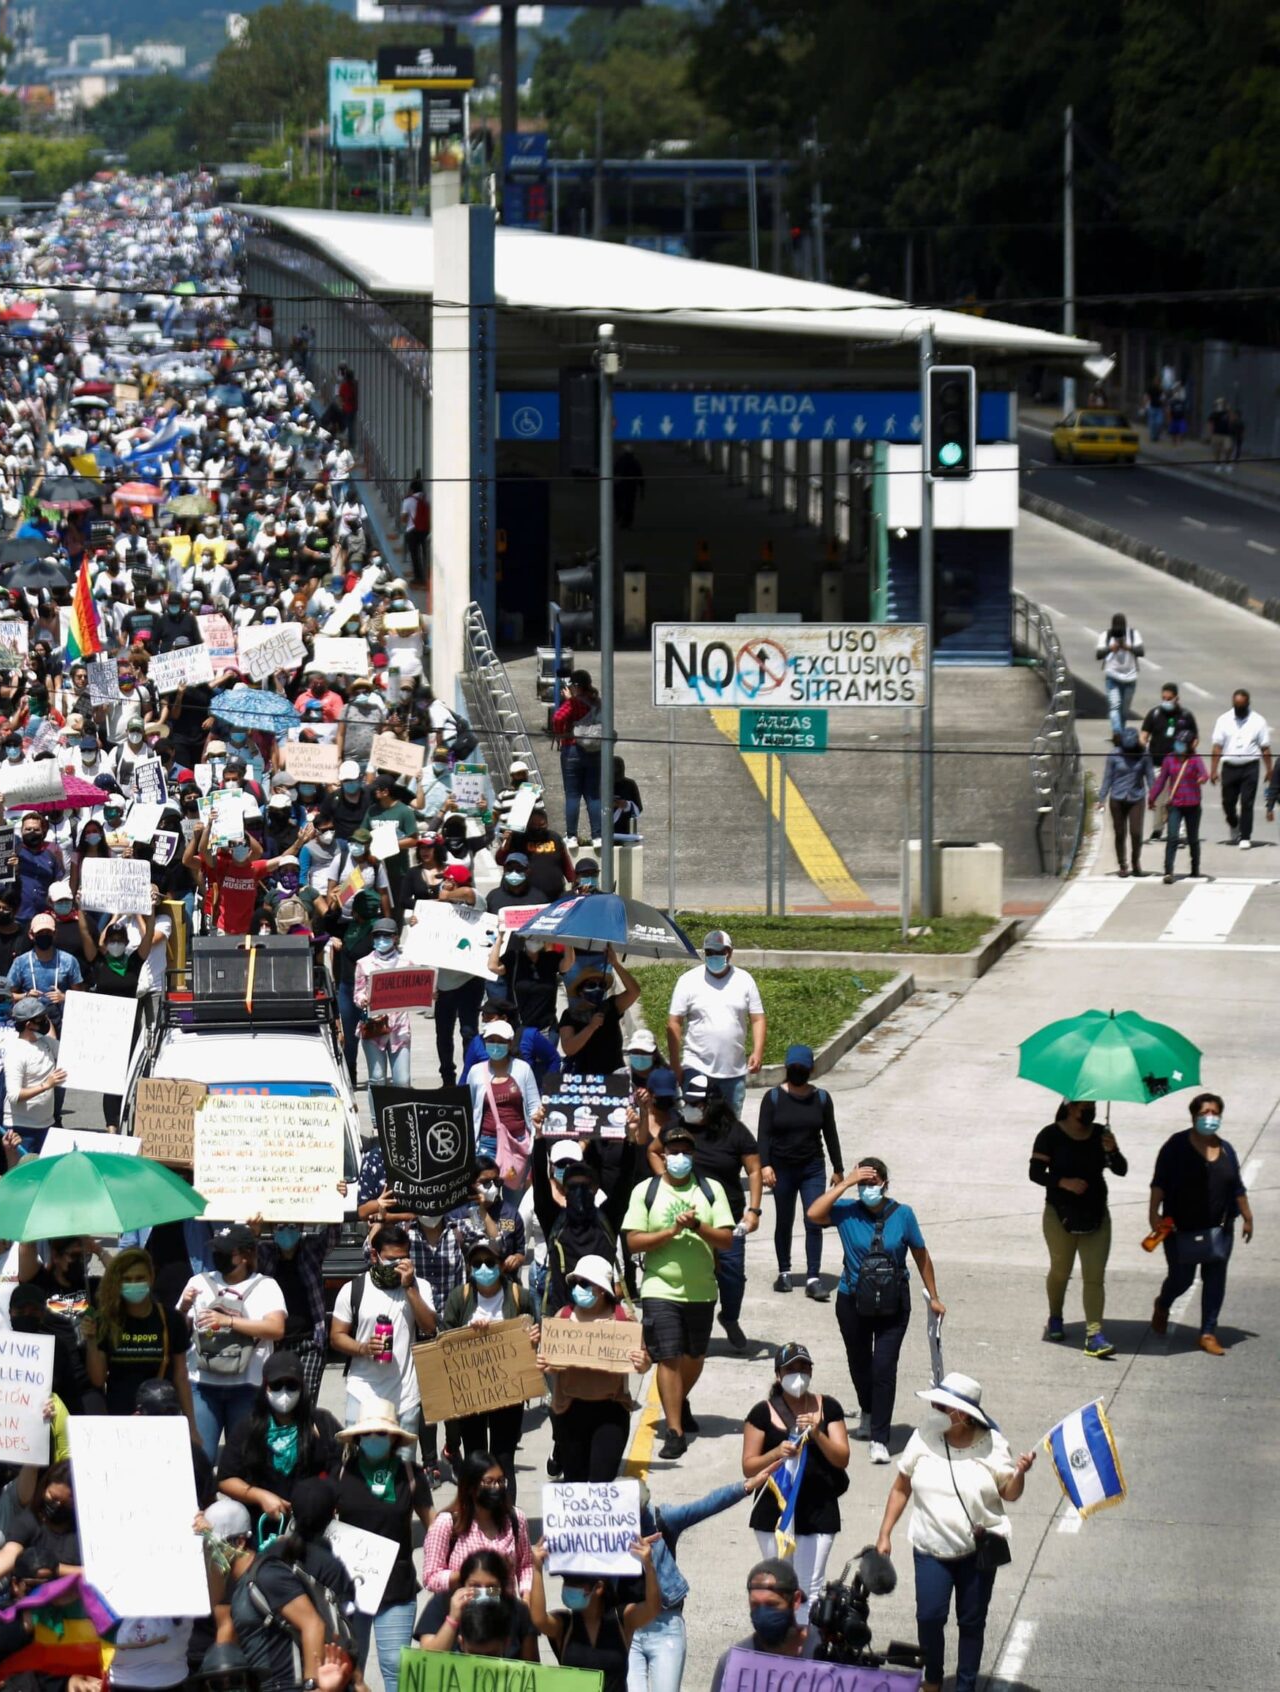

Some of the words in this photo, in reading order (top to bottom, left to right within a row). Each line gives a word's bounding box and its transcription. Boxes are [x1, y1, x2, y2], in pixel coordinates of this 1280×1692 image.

[693, 394, 816, 415] ENTRADA
[827, 630, 877, 652] USO
[664, 641, 735, 689] NO
[793, 655, 911, 676] EXCLUSIVO
[790, 678, 915, 701] SITRAMSS
[223, 880, 255, 890] MUSICAL
[563, 1073, 582, 1083] NO
[393, 1181, 405, 1194] EL
[409, 1183, 447, 1195] DINERO
[415, 1200, 436, 1210] QUE
[132, 1334, 158, 1342] apoyo
[543, 1343, 578, 1356] HASTA
[579, 1344, 595, 1357] EL
[0, 1367, 45, 1385] LLENO
[448, 1375, 470, 1395] NO
[554, 1486, 575, 1498] NO
[563, 1498, 612, 1512] FOSAS
[546, 1512, 637, 1528] CLANDESTINAS
